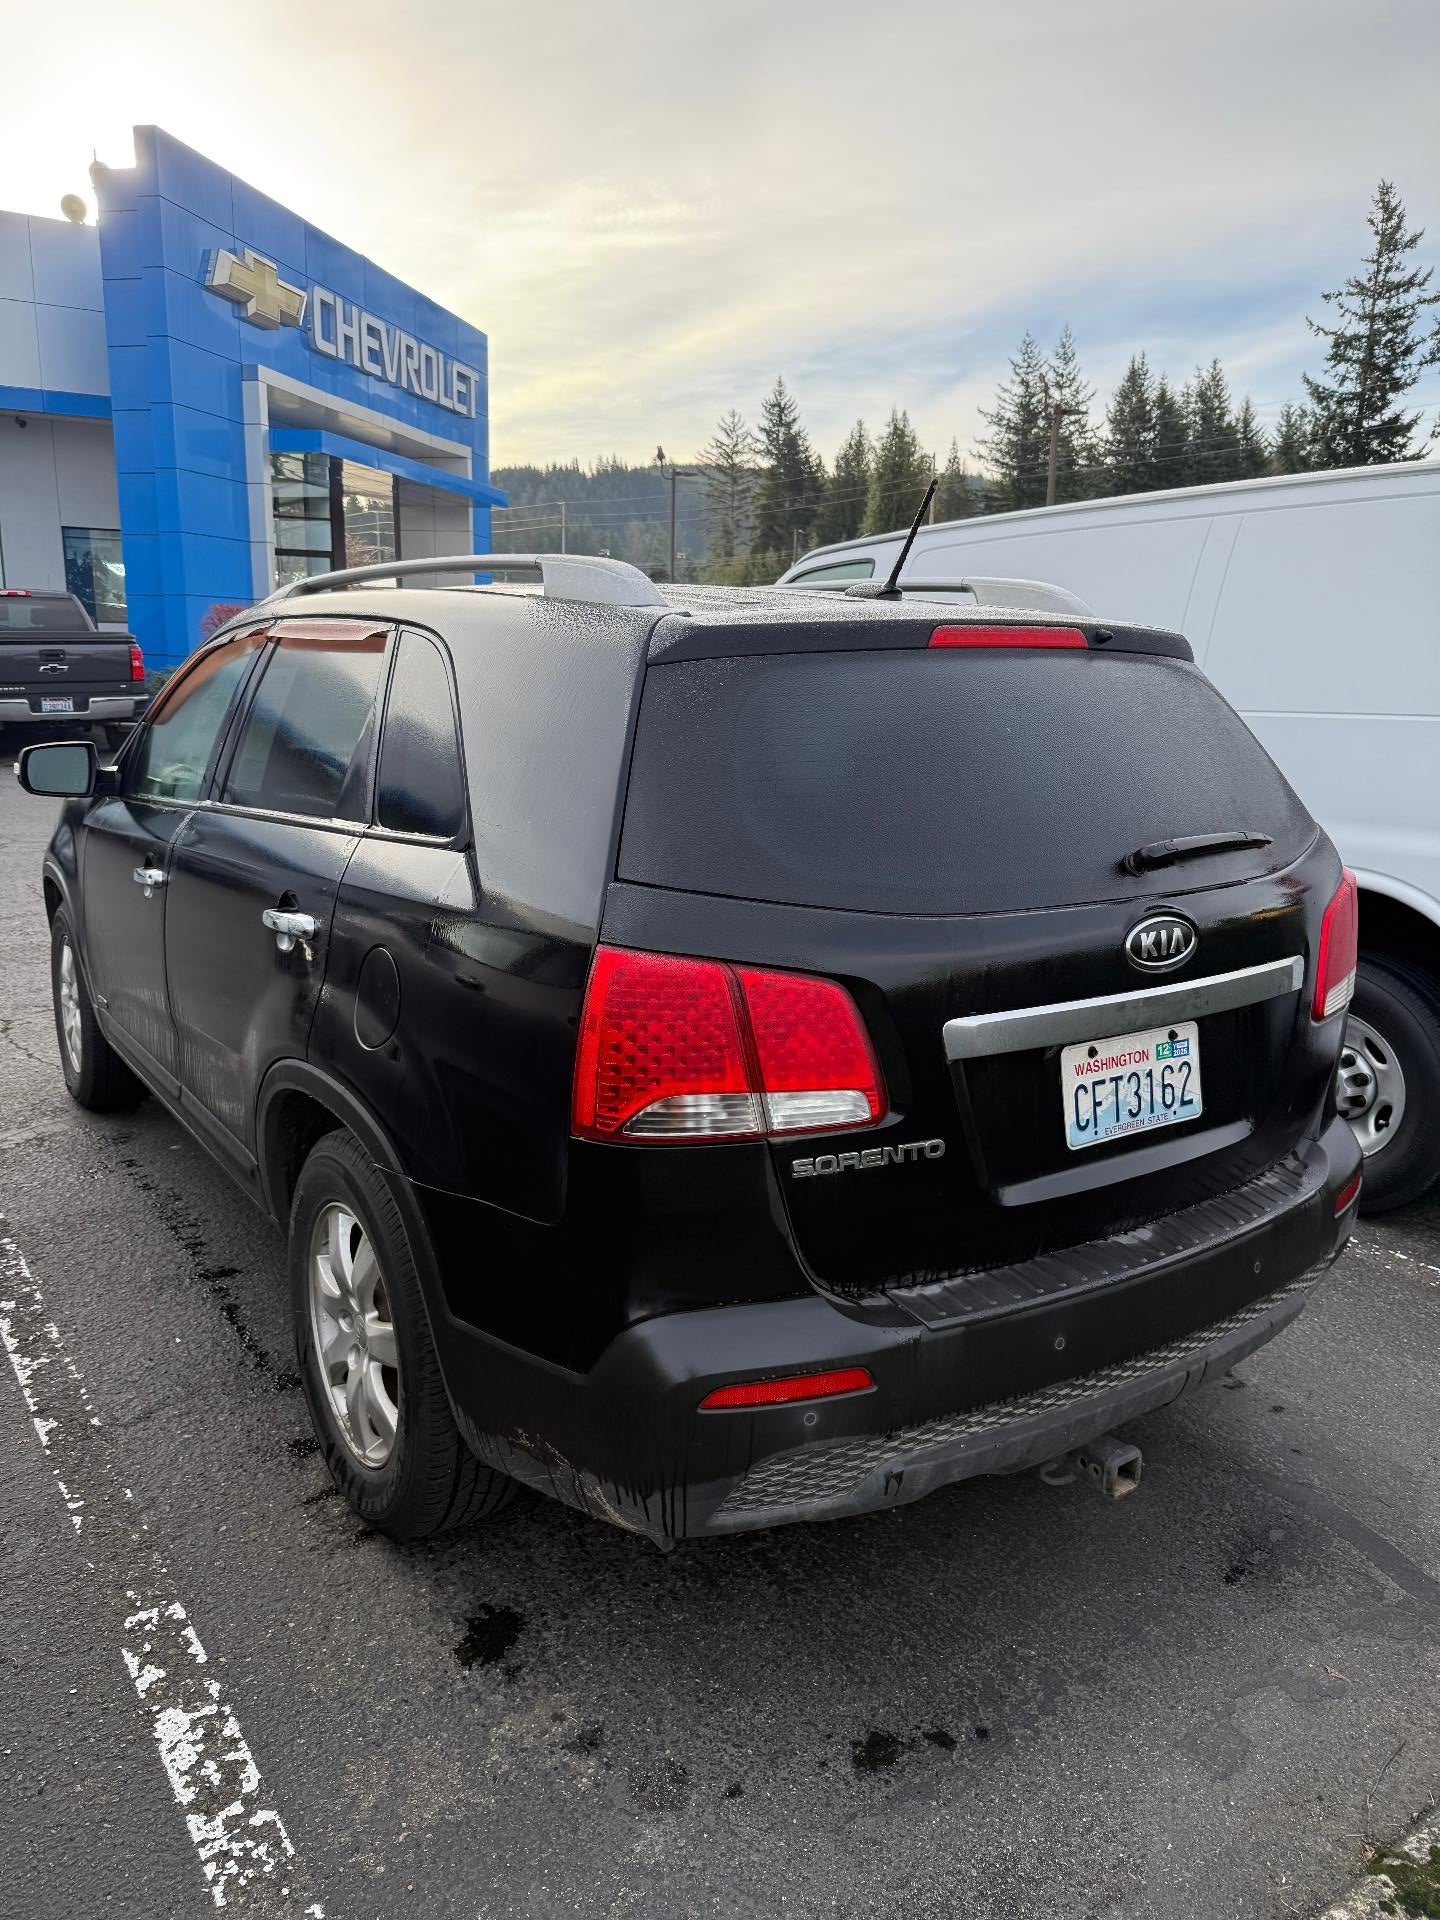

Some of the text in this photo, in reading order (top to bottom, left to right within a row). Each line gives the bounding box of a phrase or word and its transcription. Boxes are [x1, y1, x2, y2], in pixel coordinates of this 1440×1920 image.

[312, 285, 480, 419] CHEVROLET
[1139, 927, 1186, 959] KIA
[1074, 1049, 1150, 1077] WASHINGTON
[1157, 1043, 1170, 1057] 12
[1073, 1060, 1194, 1132] CFT3162
[1104, 1112, 1169, 1136] EVERGREEN STATE
[792, 1138, 946, 1179] SORENTO
